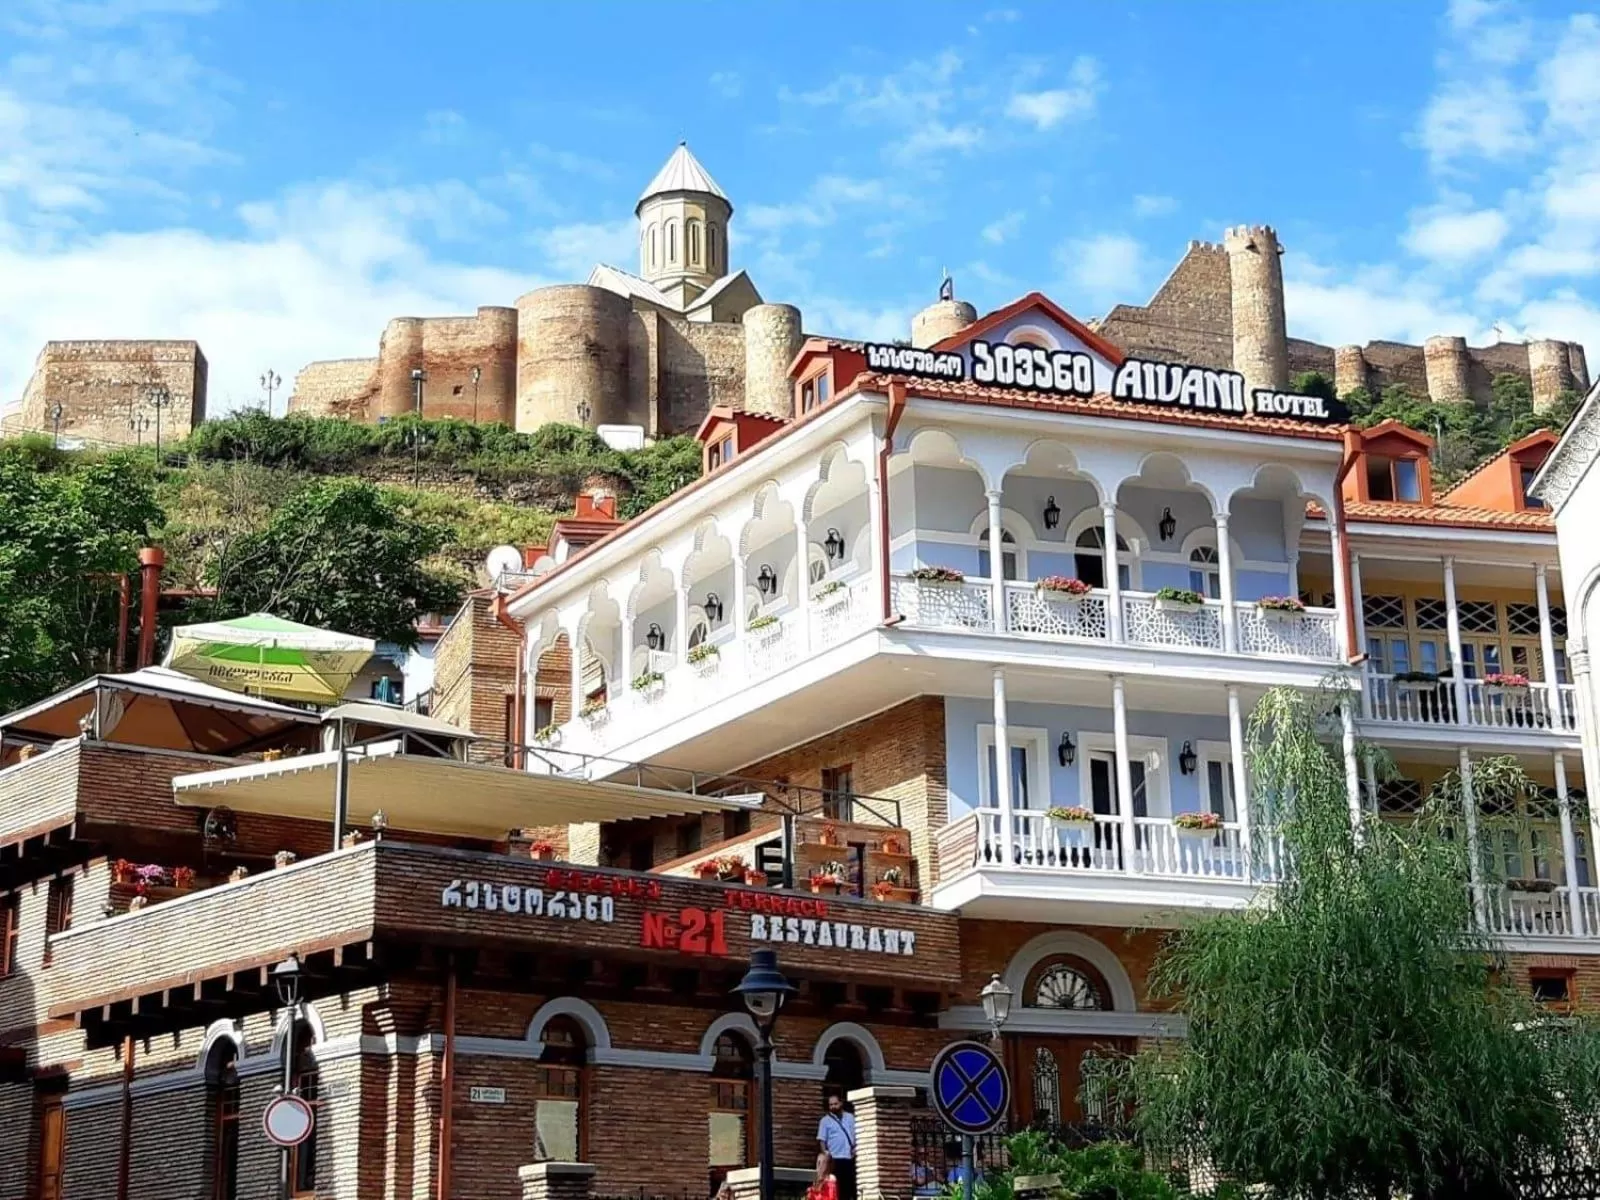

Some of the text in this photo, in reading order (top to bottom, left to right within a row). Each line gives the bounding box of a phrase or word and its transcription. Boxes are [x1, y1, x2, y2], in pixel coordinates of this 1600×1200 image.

[868, 342, 1092, 394] სასტუმრო აივანი
[1115, 360, 1329, 418] AIVANI HOTEL
[442, 879, 614, 922] რესტორანი
[724, 889, 829, 917] TERRACE
[751, 914, 915, 956] RESTAURANT
